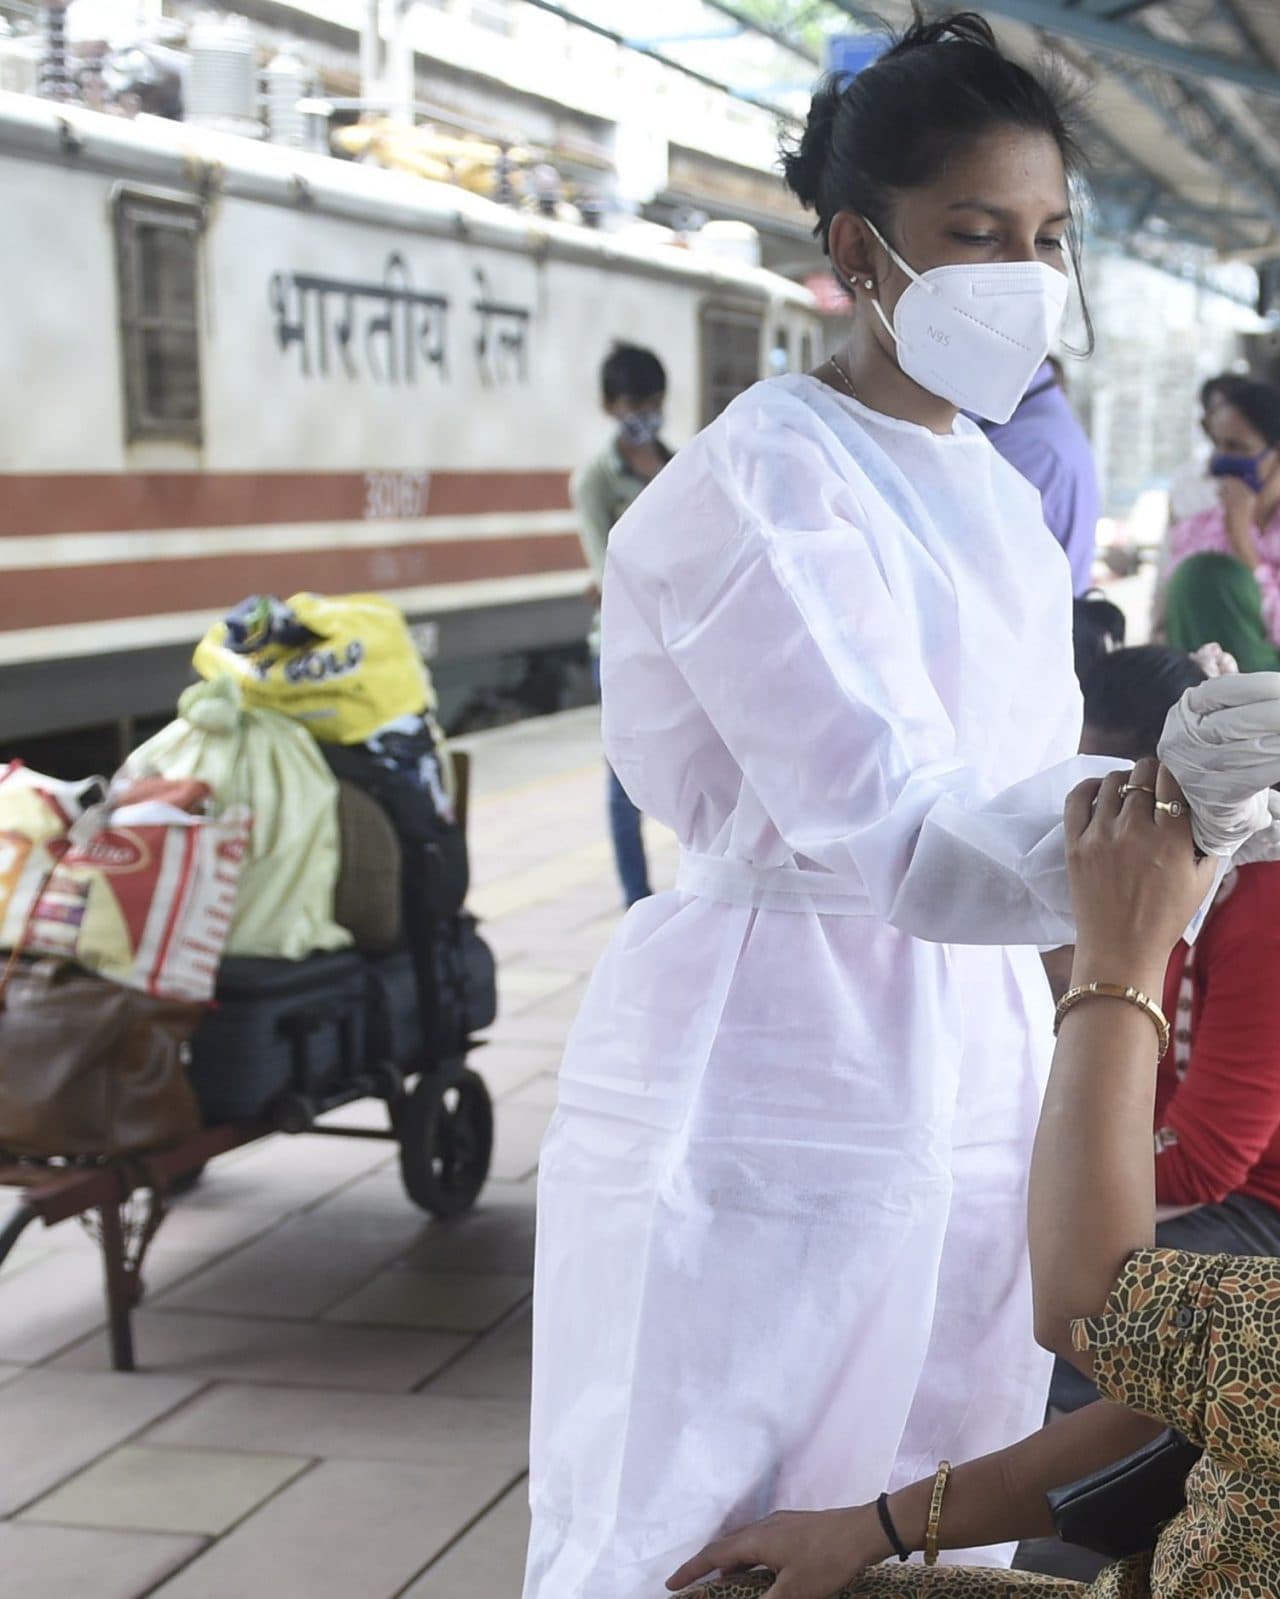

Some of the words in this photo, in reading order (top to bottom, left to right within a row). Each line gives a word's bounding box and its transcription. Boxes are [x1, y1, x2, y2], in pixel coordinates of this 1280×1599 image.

[268, 250, 450, 386] भारतीय
[472, 265, 530, 389] रेल
[927, 325, 951, 347] N95
